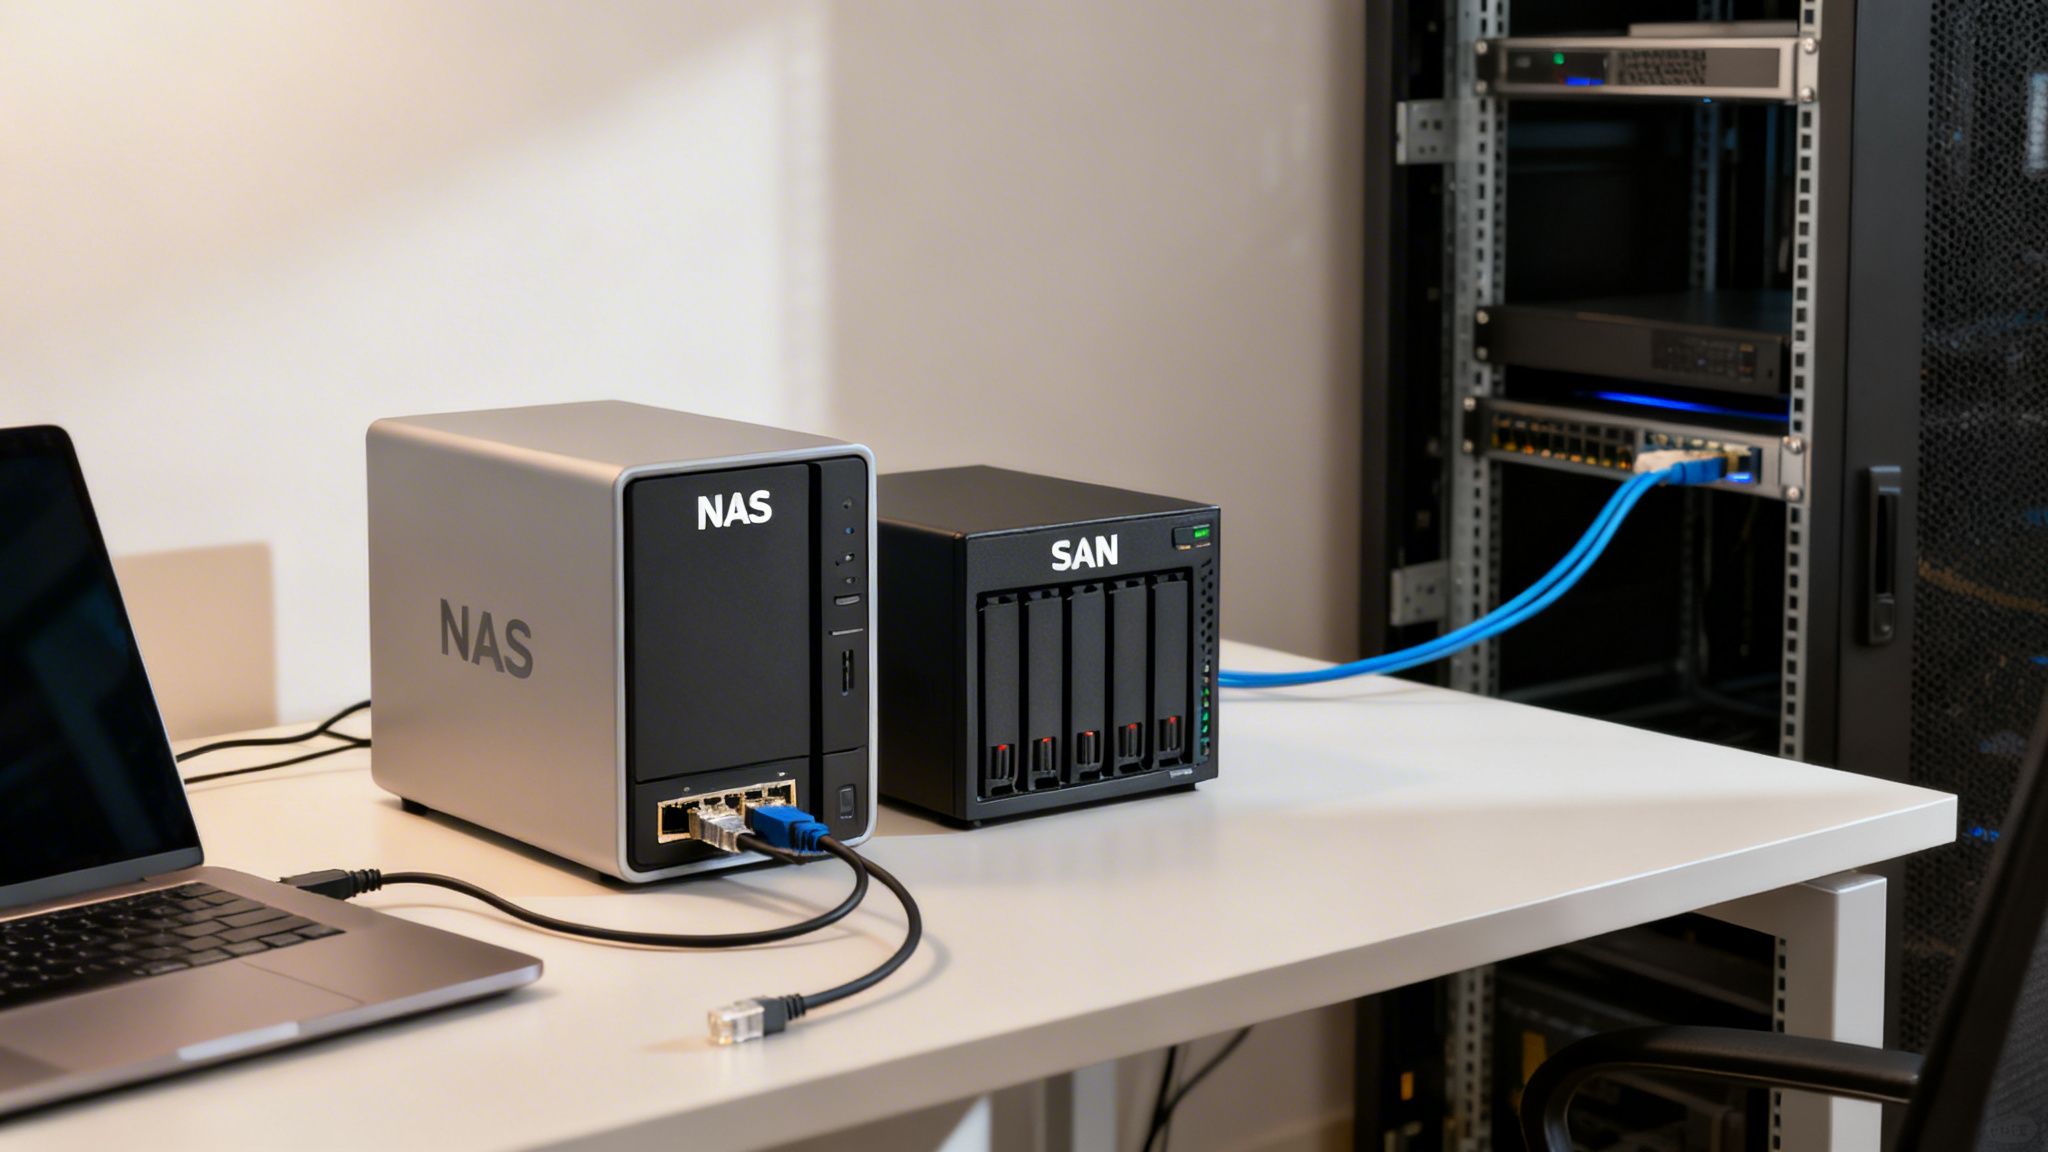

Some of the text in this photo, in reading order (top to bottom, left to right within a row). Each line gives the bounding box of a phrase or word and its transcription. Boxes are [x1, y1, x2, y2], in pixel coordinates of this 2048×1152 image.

[697, 489, 773, 531] NAS
[1051, 533, 1119, 572] SAN
[440, 598, 533, 680] NAS
